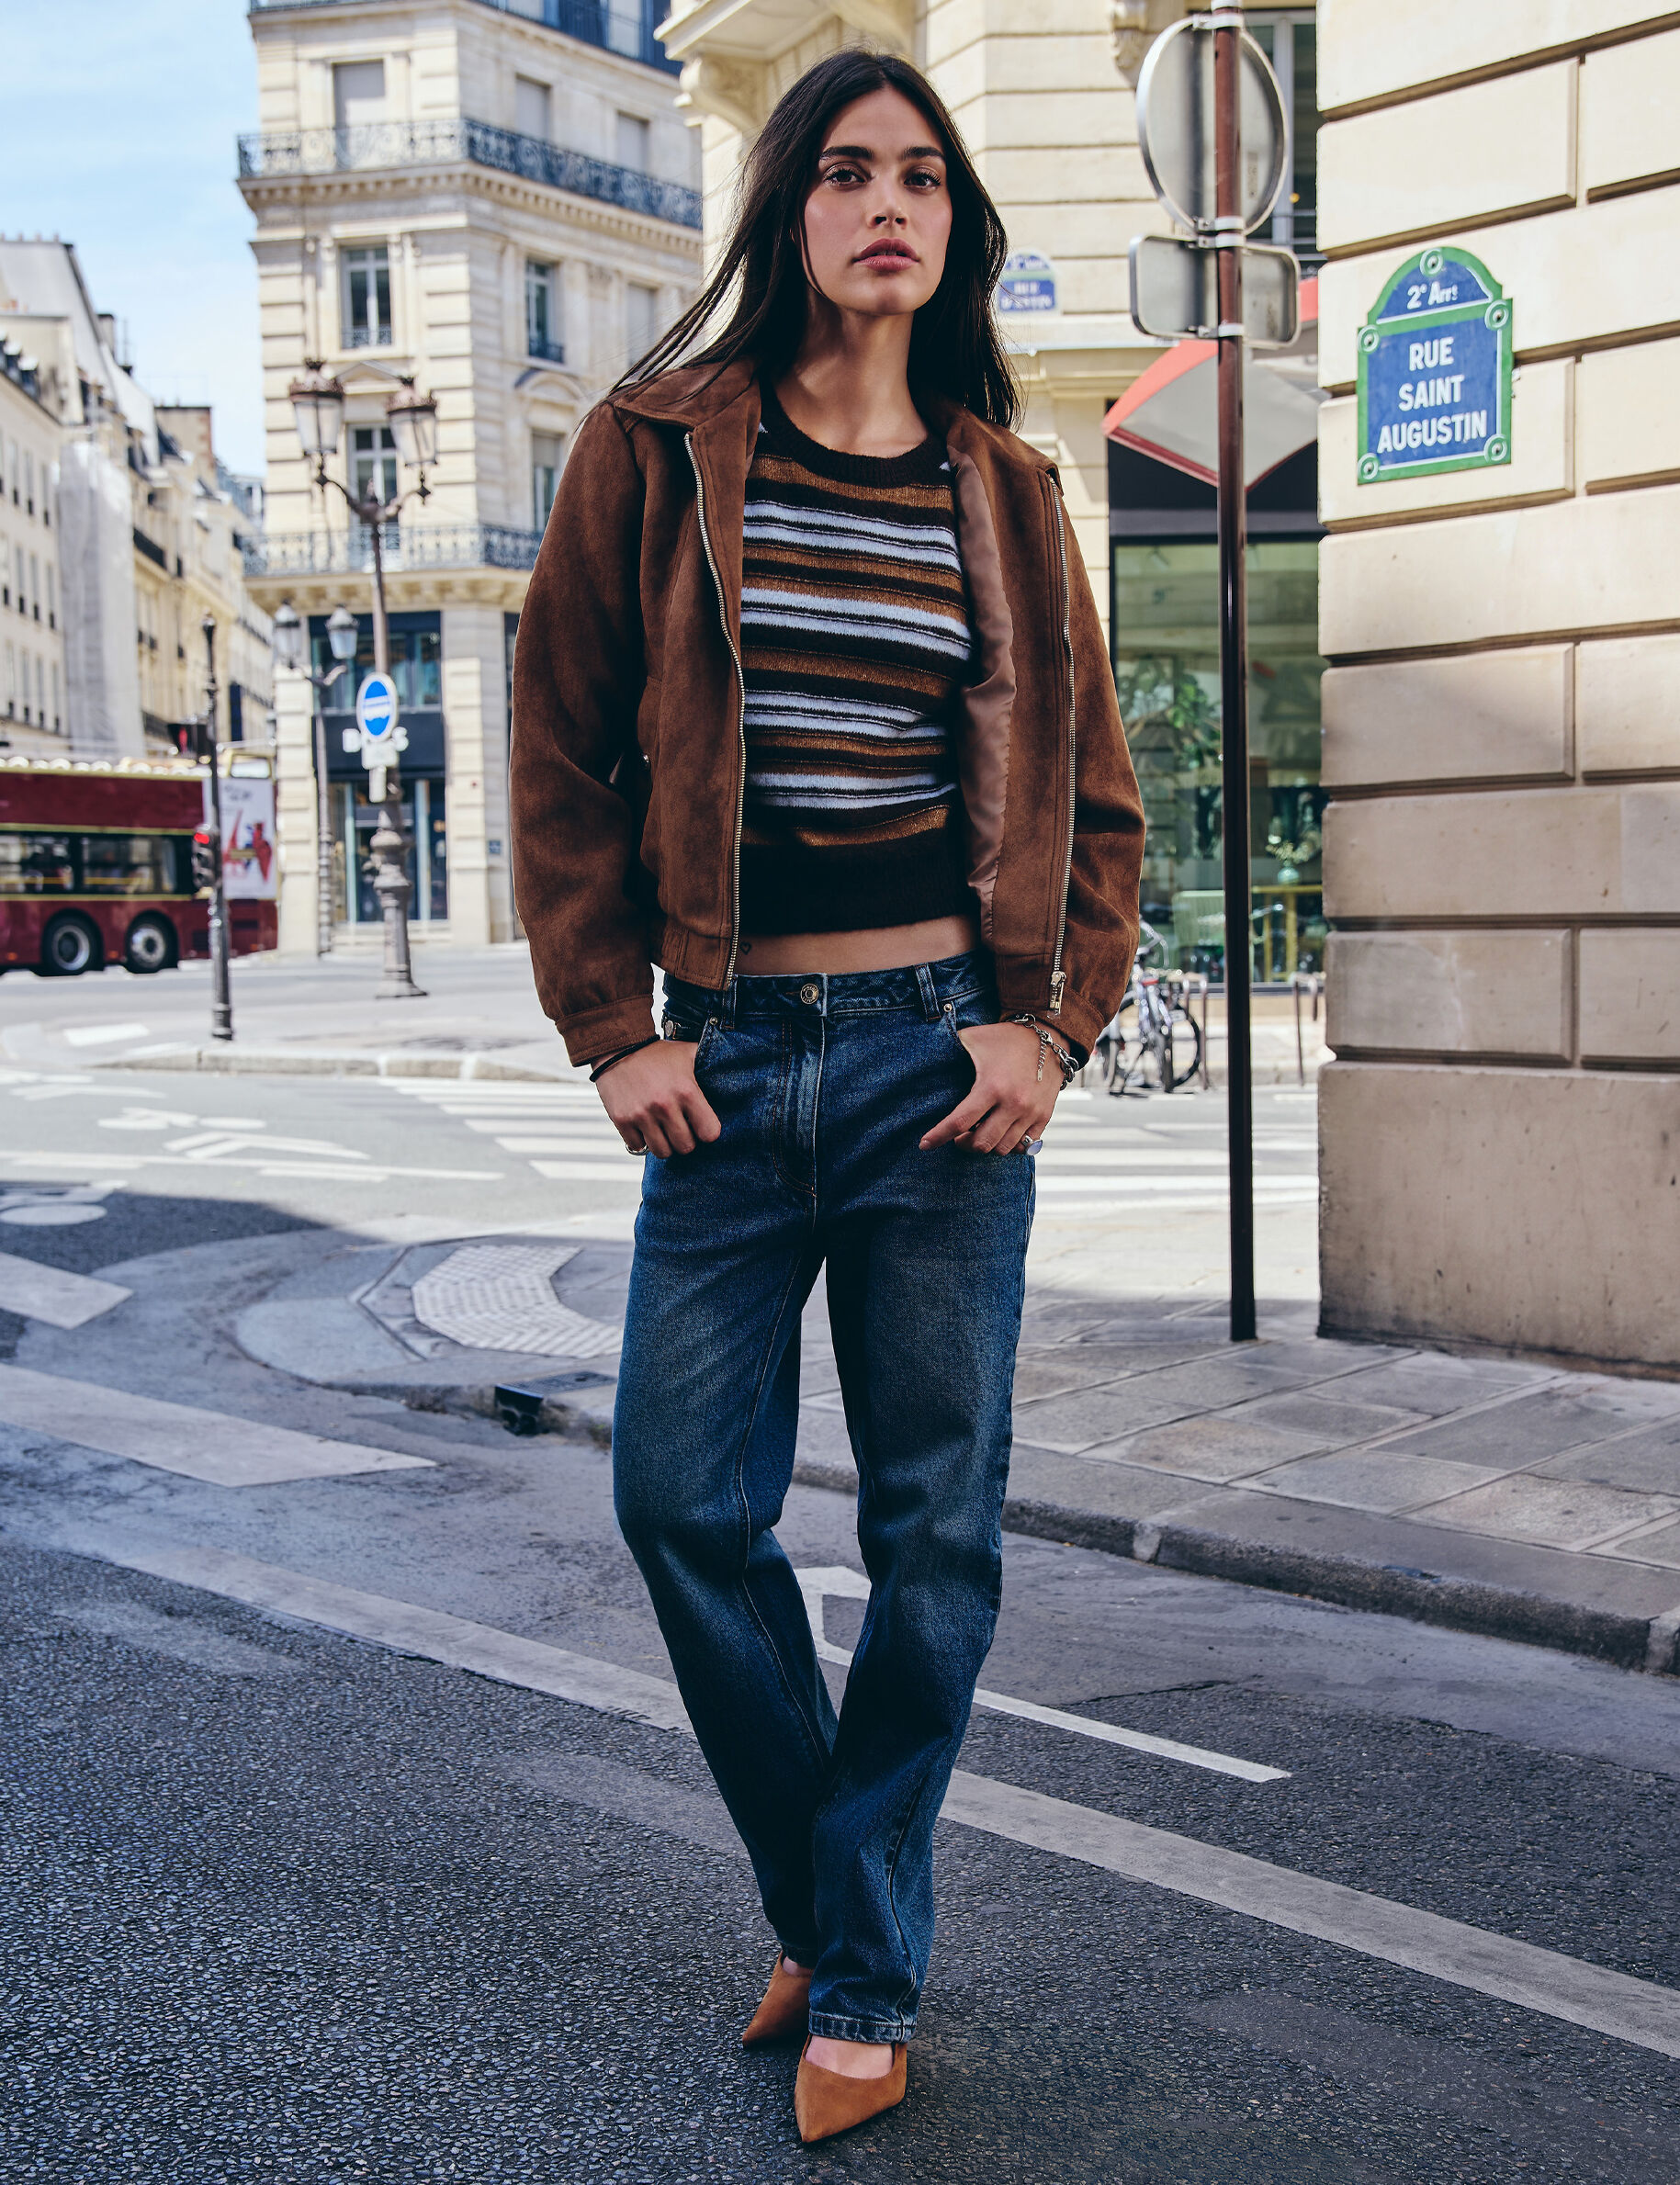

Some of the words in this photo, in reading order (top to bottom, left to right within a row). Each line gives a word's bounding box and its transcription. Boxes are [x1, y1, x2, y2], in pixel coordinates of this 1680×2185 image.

[1409, 337, 1454, 371] RUE
[1399, 375, 1465, 411] SAINT
[1377, 410, 1486, 453] AUGUSTIN
